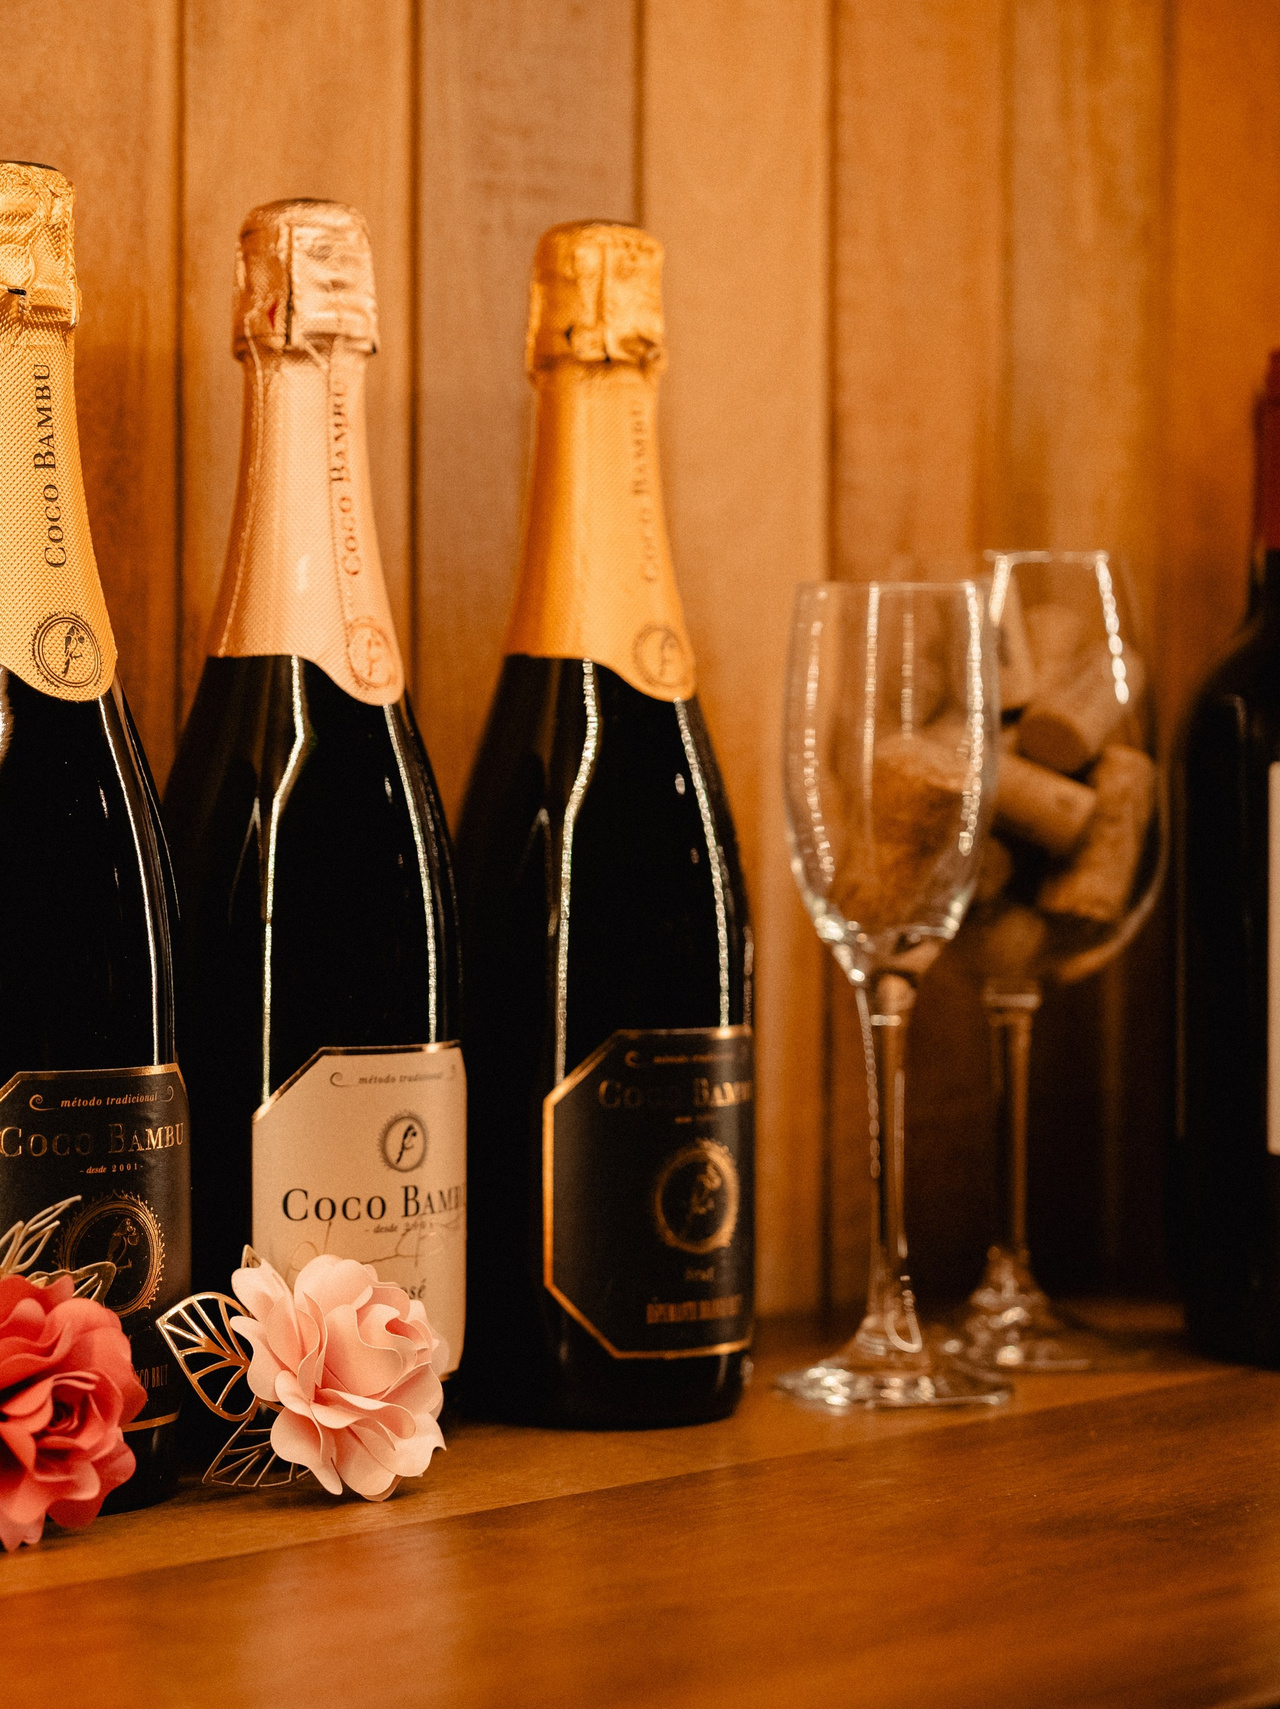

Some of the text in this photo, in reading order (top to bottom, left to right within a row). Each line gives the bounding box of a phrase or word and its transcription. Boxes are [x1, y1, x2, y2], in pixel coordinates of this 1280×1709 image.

[33, 363, 67, 568] COCO BAMBU
[60, 1091, 158, 1108] método tradicional
[108, 1122, 184, 1154] BAMBU
[282, 1187, 386, 1222] COCO
[400, 1277, 427, 1300] sé
